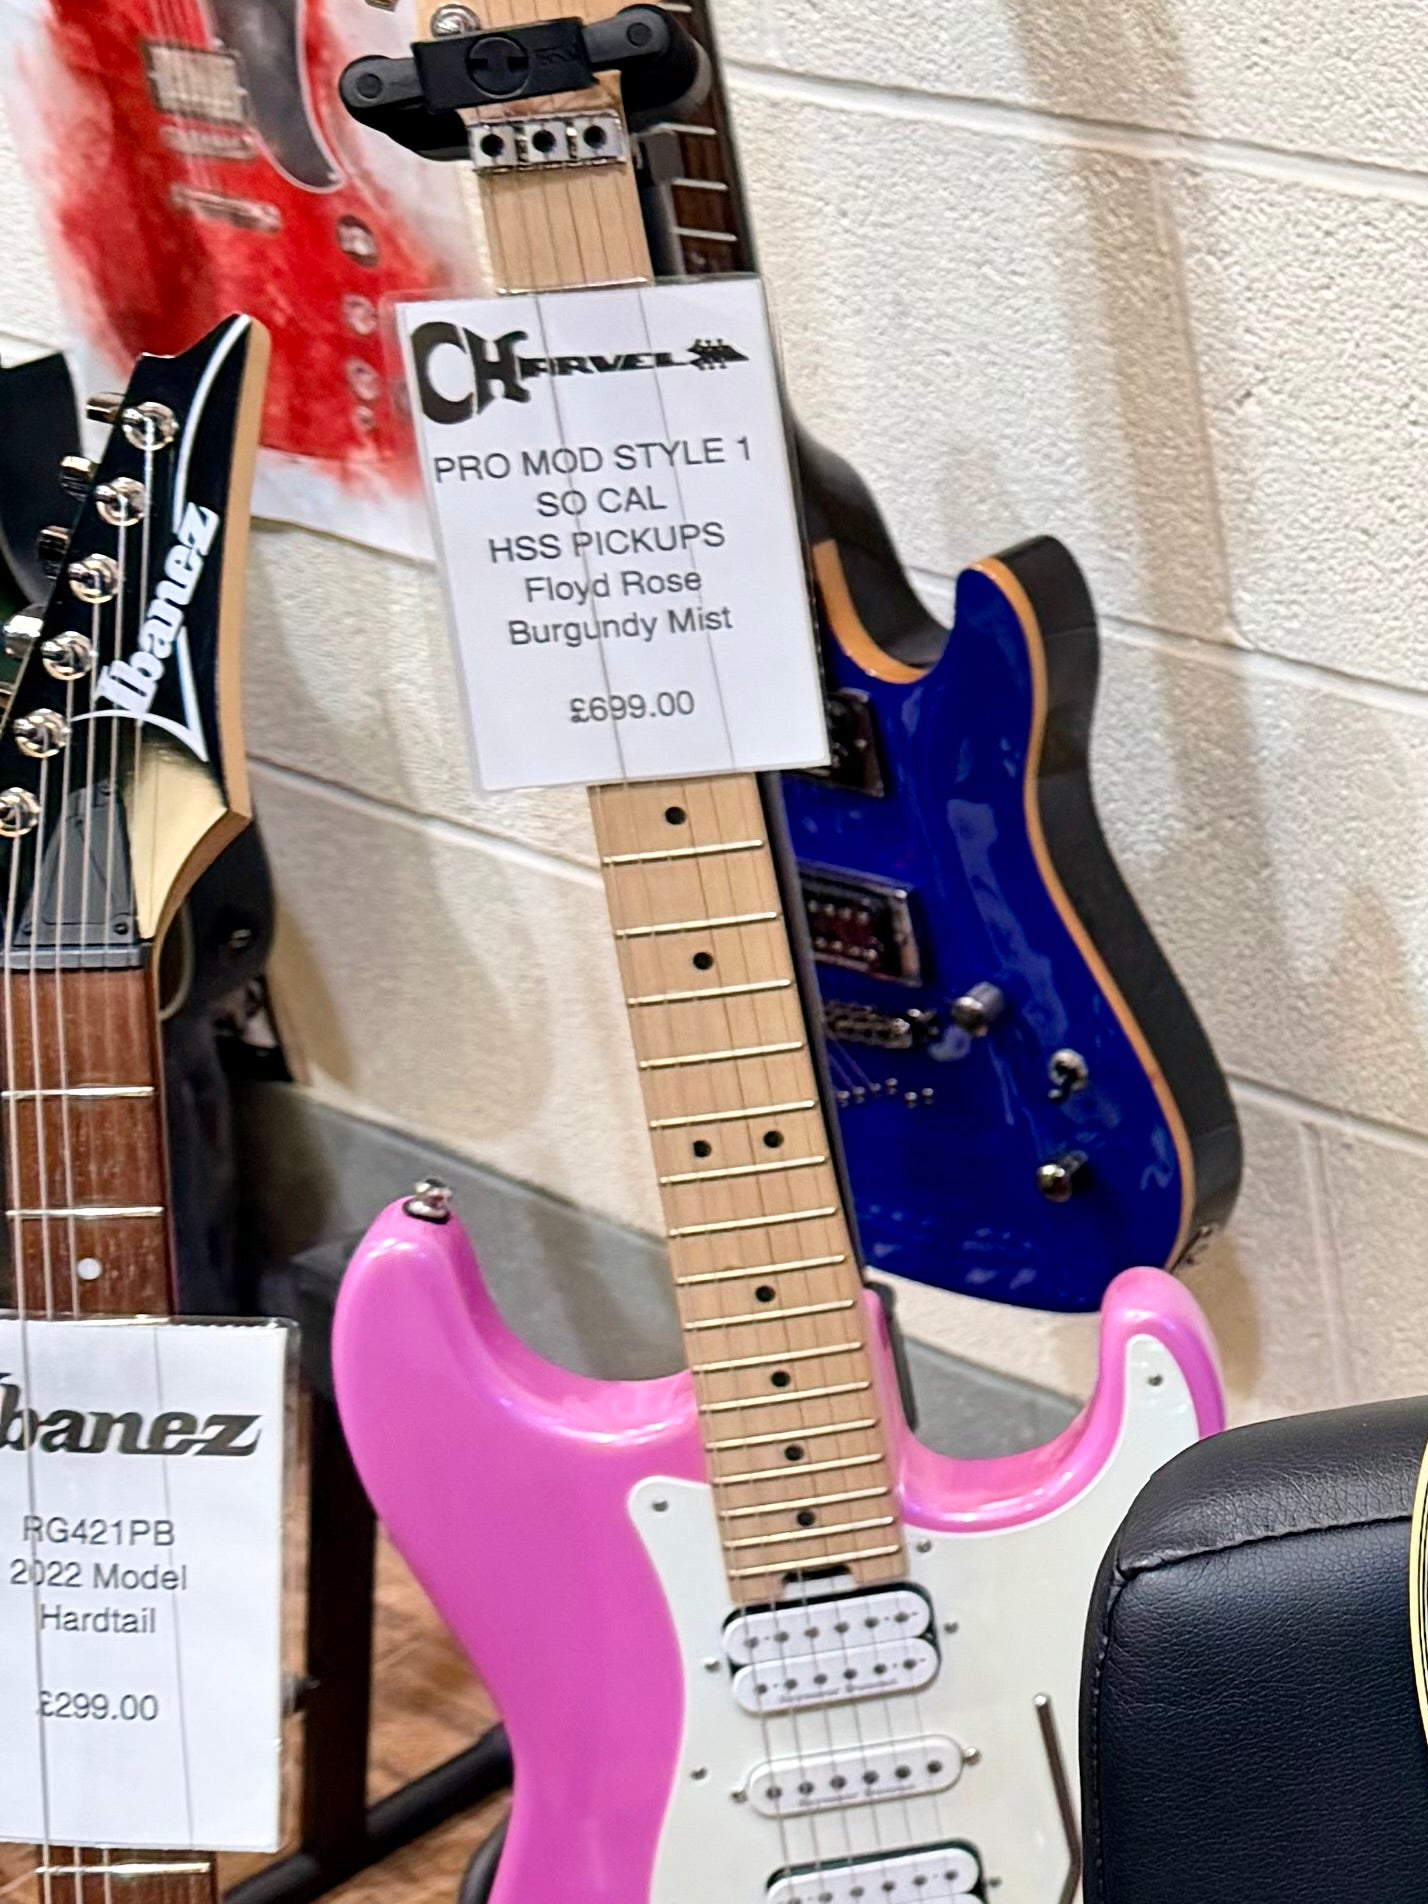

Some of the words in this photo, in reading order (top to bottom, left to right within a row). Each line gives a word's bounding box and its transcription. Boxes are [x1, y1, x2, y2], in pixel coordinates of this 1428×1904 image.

[434, 453, 511, 484] PRO
[522, 446, 604, 477] MOD
[614, 437, 727, 472] STYLE
[736, 435, 752, 462] 1
[537, 489, 588, 517] SO
[597, 485, 668, 514] CAL
[488, 533, 562, 564] HSS
[571, 521, 727, 557] PICKUPS
[524, 571, 611, 607] Floyd
[620, 569, 702, 597] Rose
[94, 501, 221, 716] Ibanez
[508, 612, 659, 648] Burgundy
[667, 606, 735, 634] Mist
[569, 689, 696, 724] £699.00
[0, 1372, 264, 1458] banez
[22, 1514, 177, 1547] RG421PB
[9, 1558, 84, 1589] 2022
[92, 1563, 189, 1591] Model
[38, 1603, 158, 1635] Hardtail
[37, 1689, 160, 1721] £299.00
